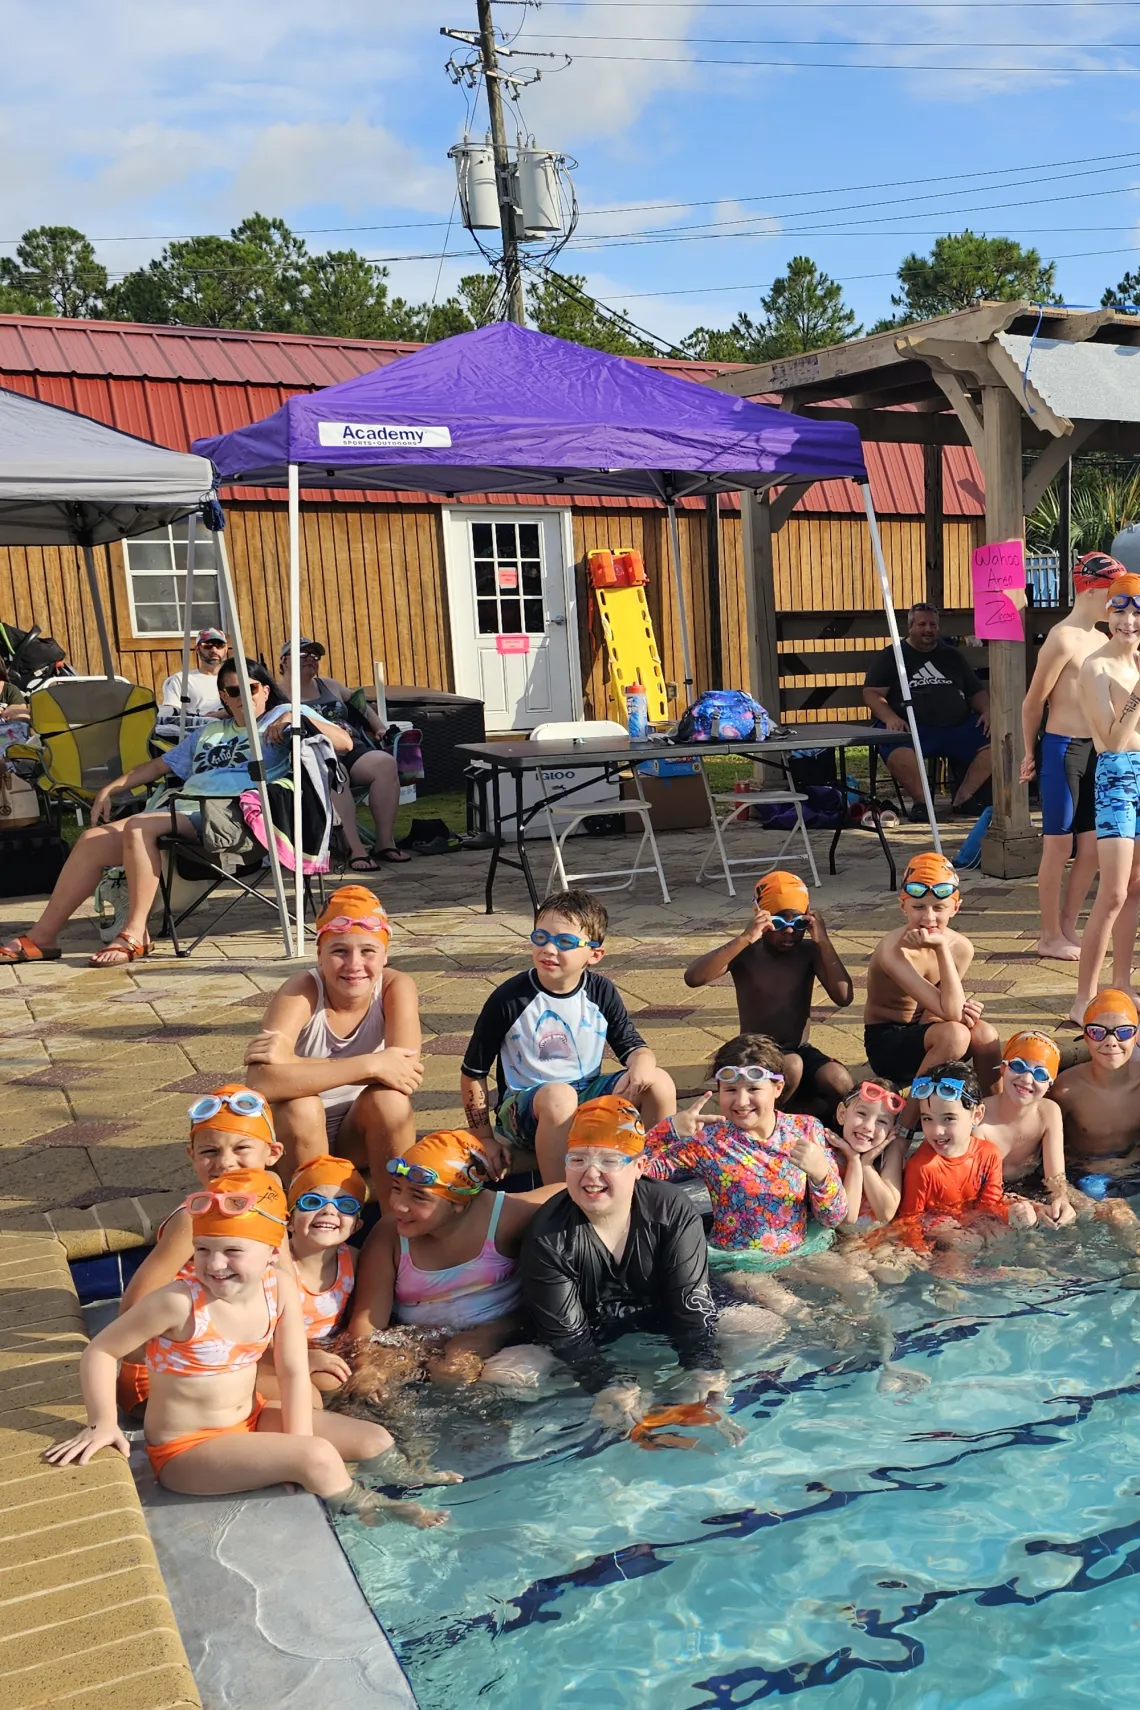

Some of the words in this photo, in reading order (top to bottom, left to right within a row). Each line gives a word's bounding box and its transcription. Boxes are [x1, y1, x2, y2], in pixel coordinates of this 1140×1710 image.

[342, 425, 424, 444] Academy
[975, 543, 1020, 567] Wahoo
[987, 568, 1013, 588] Area
[908, 677, 953, 688] adidas
